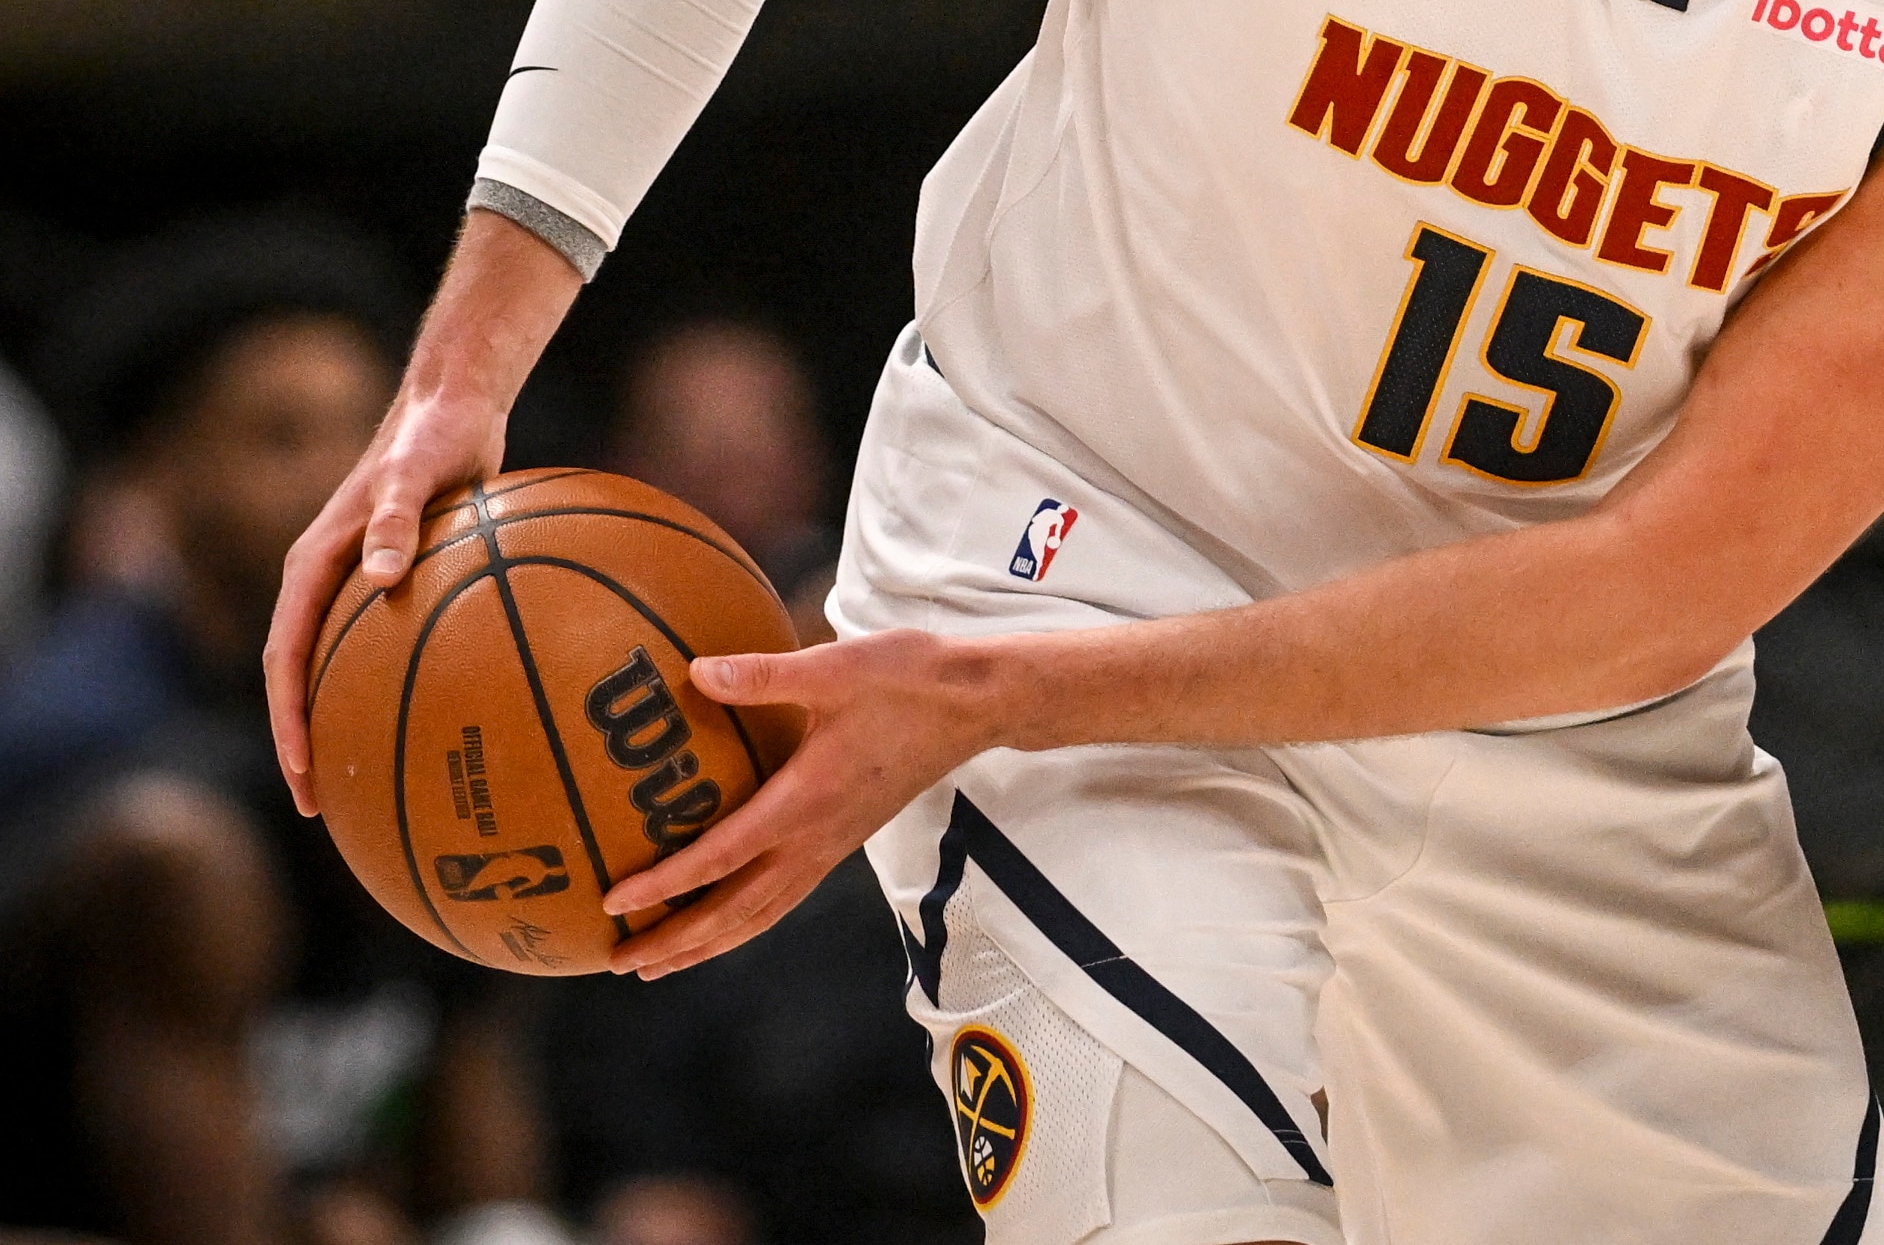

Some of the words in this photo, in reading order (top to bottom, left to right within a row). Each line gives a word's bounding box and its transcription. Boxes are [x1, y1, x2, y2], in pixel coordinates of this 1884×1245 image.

[1286, 12, 1851, 295] NUGGETS
[1351, 220, 1652, 486] 15
[1012, 556, 1034, 575] NBA
[461, 725, 487, 777] OFFICIAL
[585, 644, 721, 910] Wil
